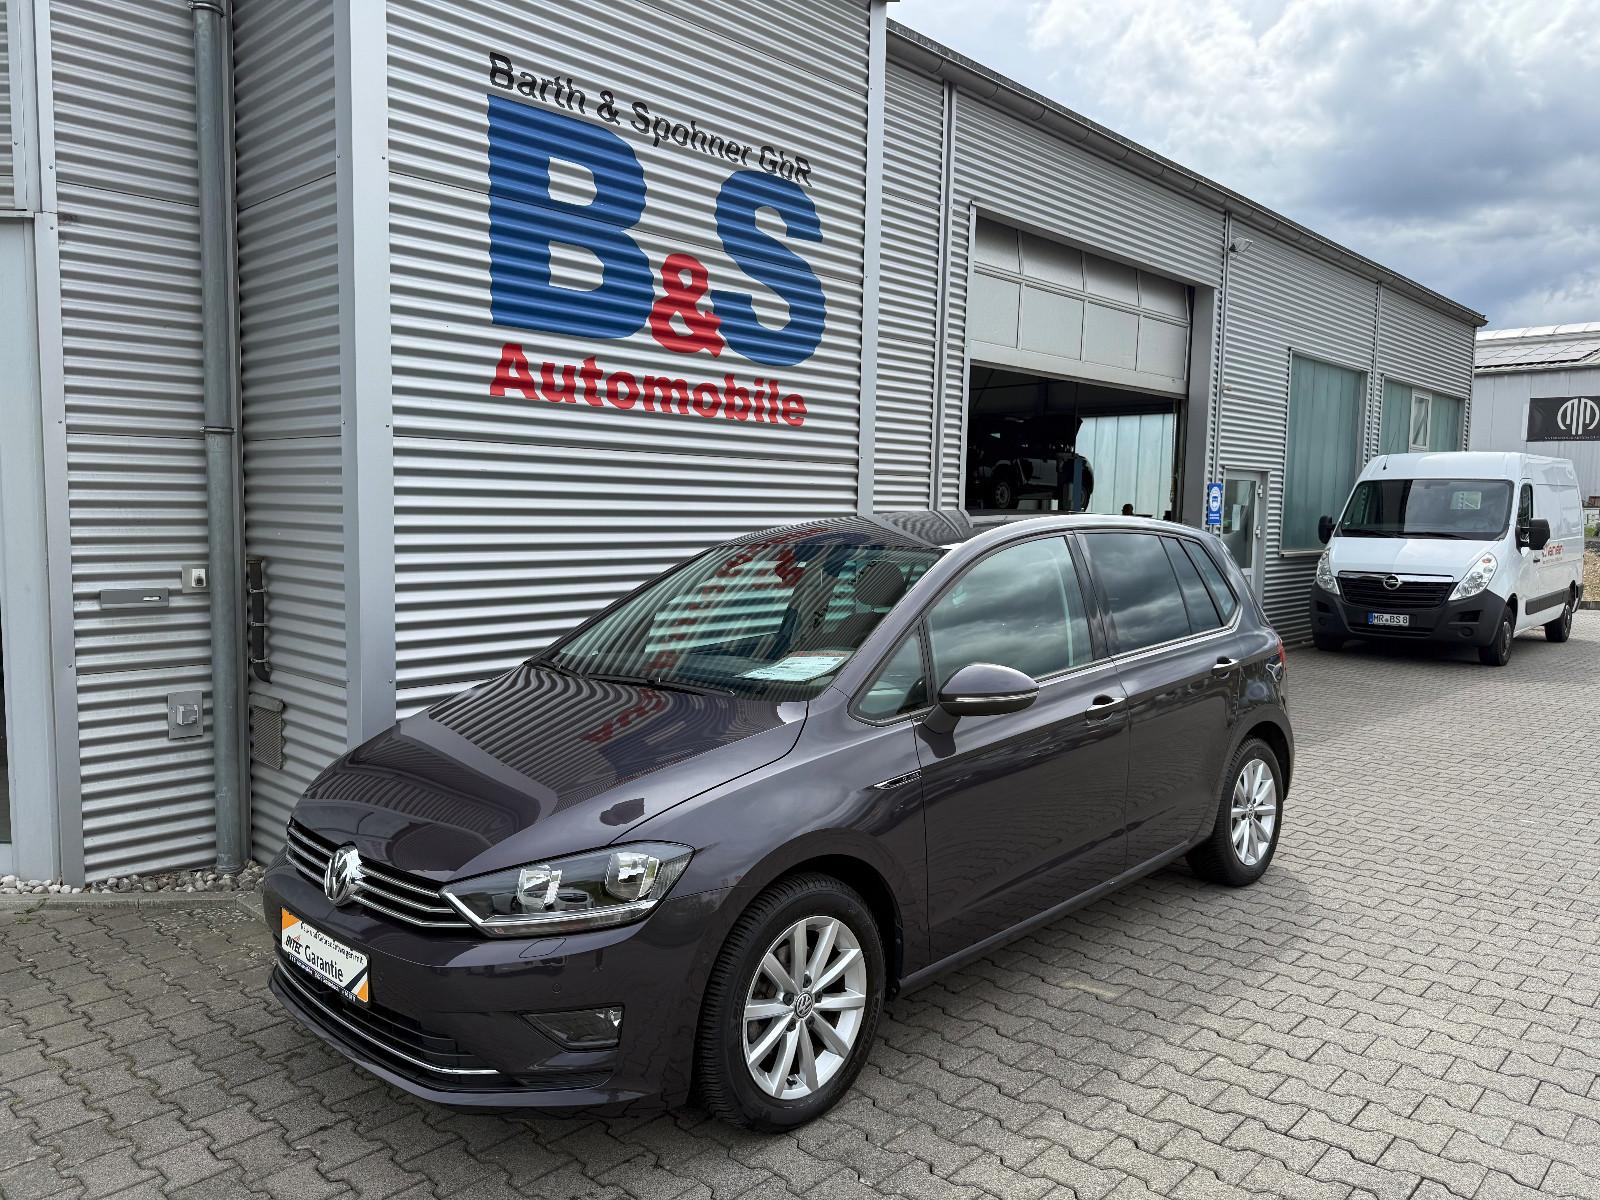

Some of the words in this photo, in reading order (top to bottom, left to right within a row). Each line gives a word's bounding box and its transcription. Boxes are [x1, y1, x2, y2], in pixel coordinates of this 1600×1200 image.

[489, 51, 586, 114] Barth
[596, 90, 621, 125] &
[630, 101, 752, 168] Spohner
[759, 144, 813, 188] GbR
[489, 342, 808, 427] Automobile
[304, 944, 344, 983] Garantie
